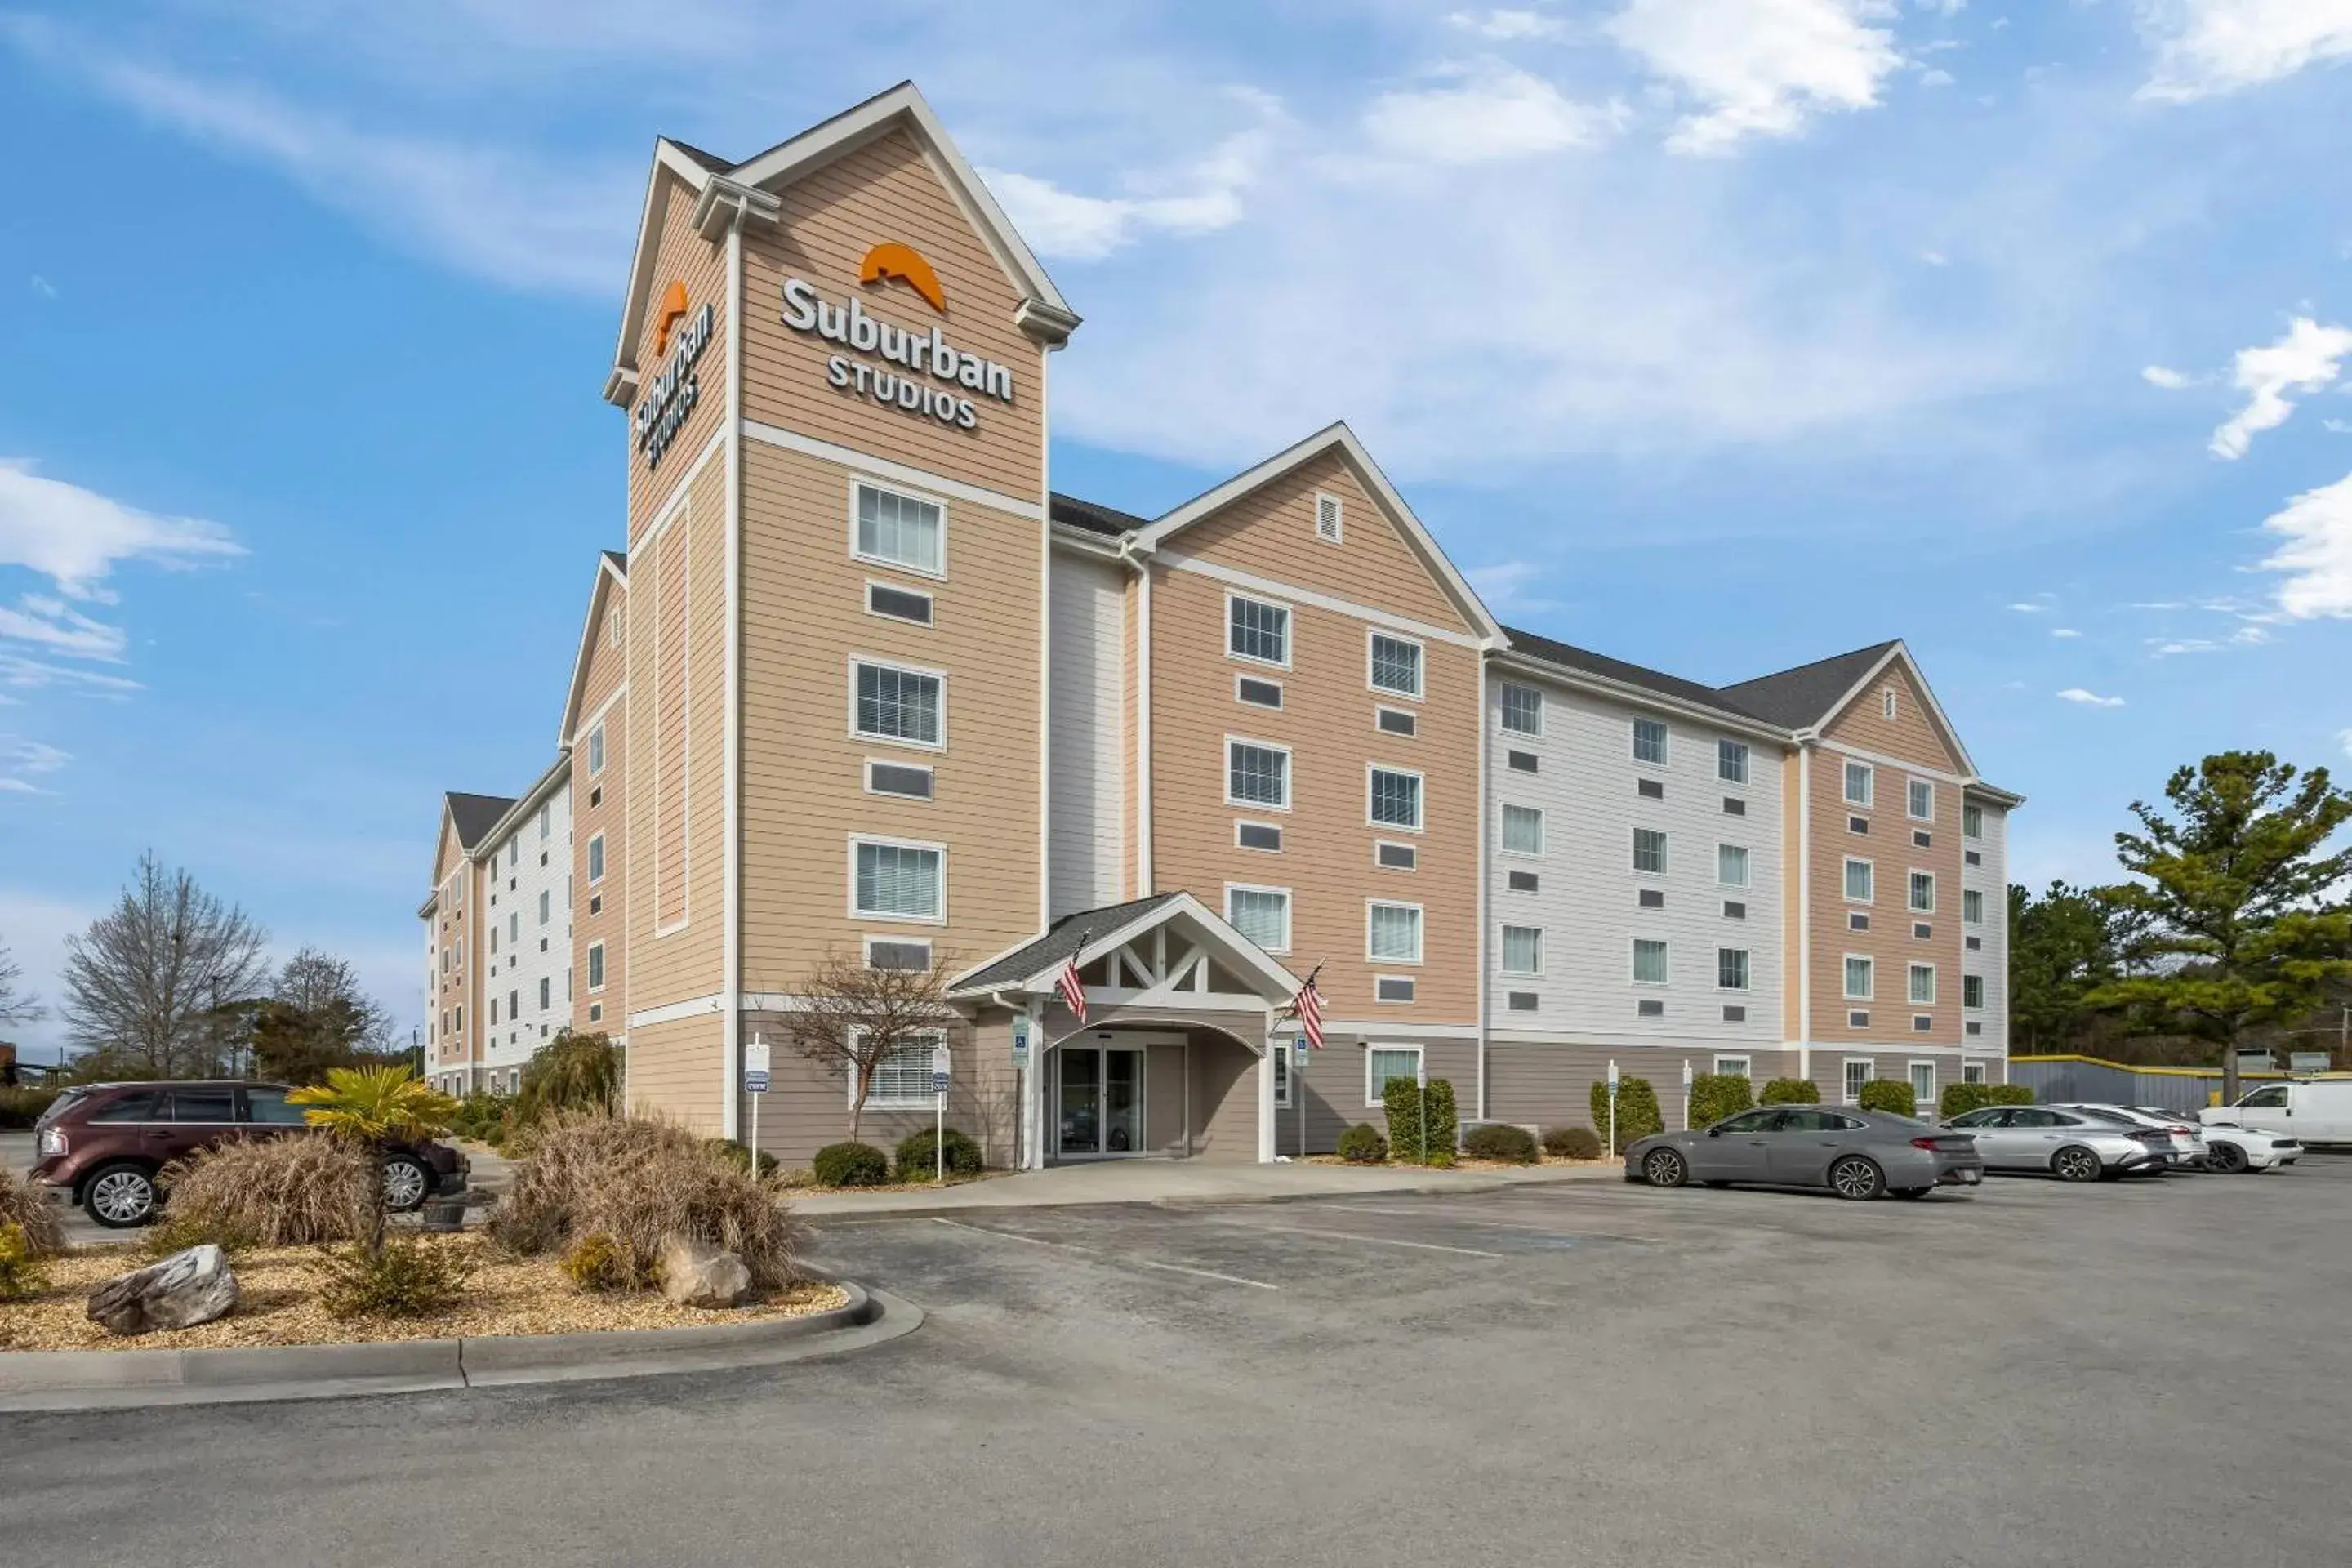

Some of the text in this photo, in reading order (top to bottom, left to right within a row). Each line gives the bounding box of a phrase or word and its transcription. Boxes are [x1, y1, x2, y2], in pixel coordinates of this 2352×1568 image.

[636, 303, 713, 453] Suburban
[782, 278, 1013, 402] Suburban
[827, 354, 978, 429] STUDIOS
